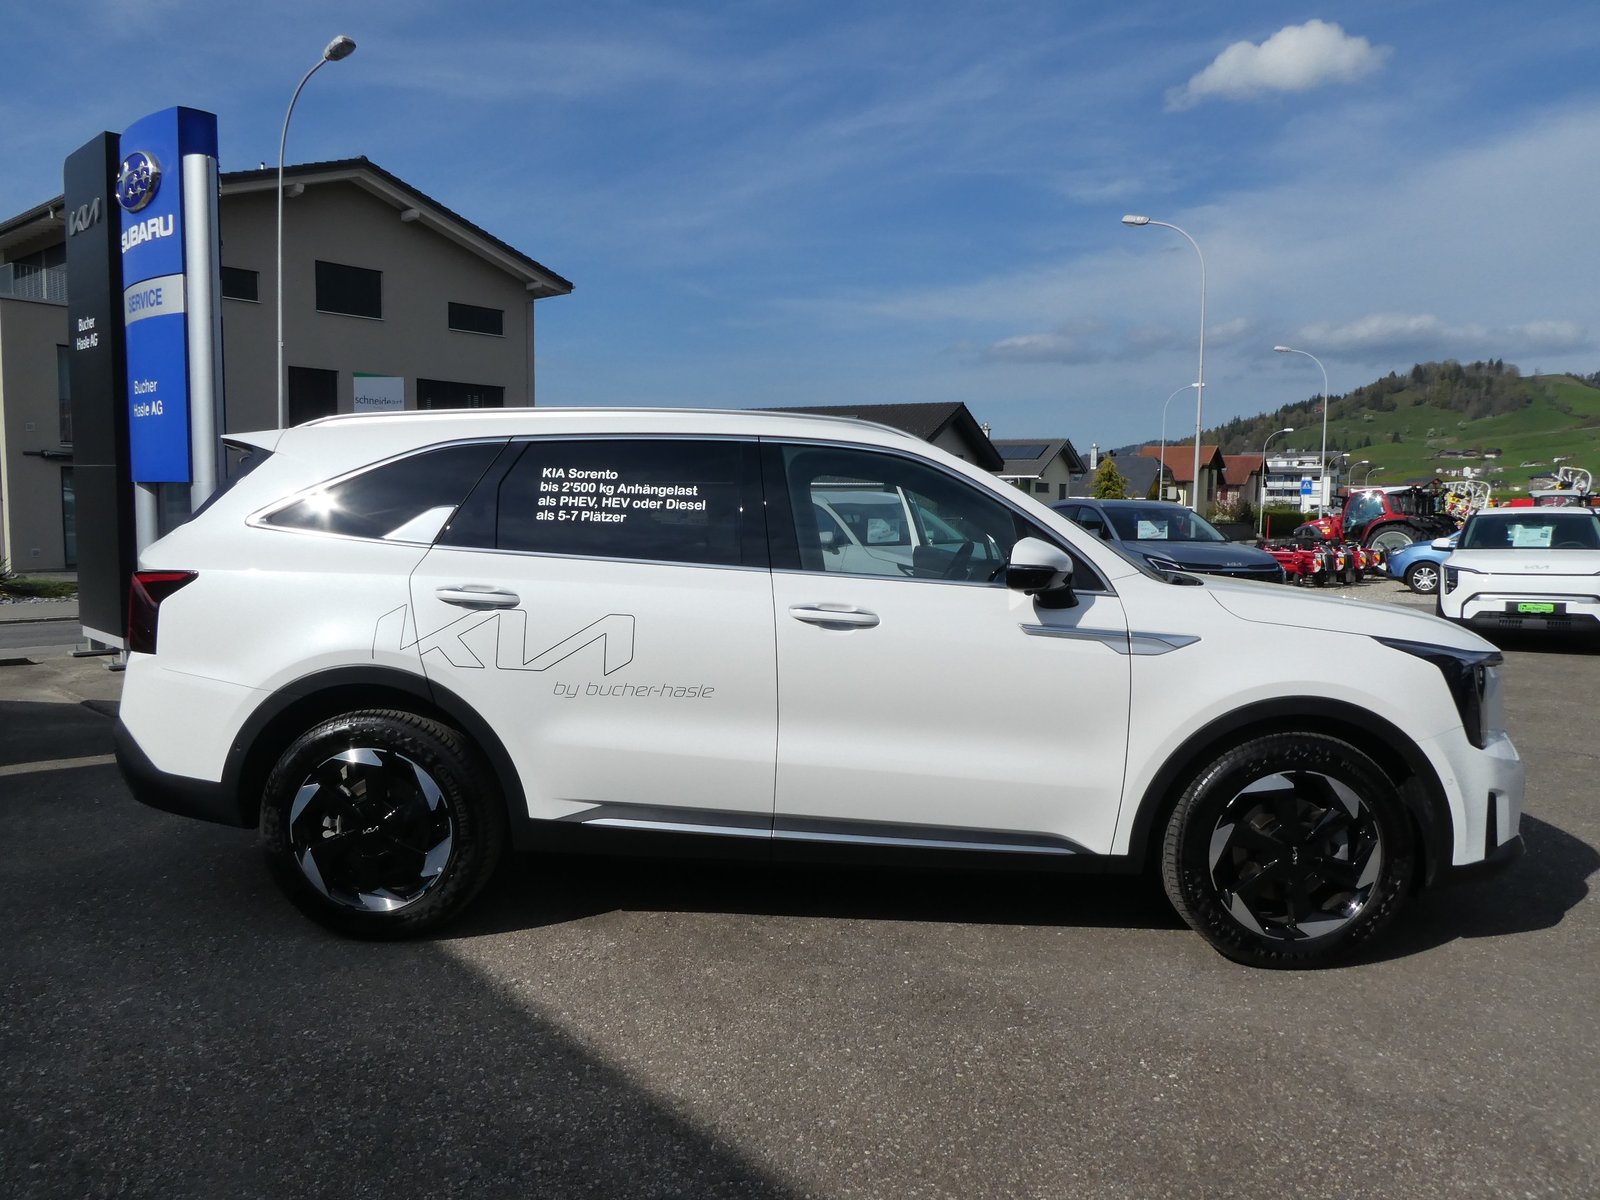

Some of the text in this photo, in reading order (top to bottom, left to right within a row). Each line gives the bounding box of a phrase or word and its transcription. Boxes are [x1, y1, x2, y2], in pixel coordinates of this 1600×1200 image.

[121, 214, 174, 254] SUBARU
[128, 287, 163, 314] SERVICE
[78, 316, 96, 332] Bucher
[76, 333, 99, 351] Hasle AG
[134, 380, 158, 395] Bucher
[133, 400, 163, 417] Hasle AG
[542, 467, 619, 480] KIA Sorento
[540, 481, 699, 498] bis 2'500 kg Anhängelast
[537, 496, 707, 511] als PHEV, HEV oder Diesel
[536, 510, 628, 523] als 5-7 Plätzer
[553, 681, 716, 699] by bucher-hasle
